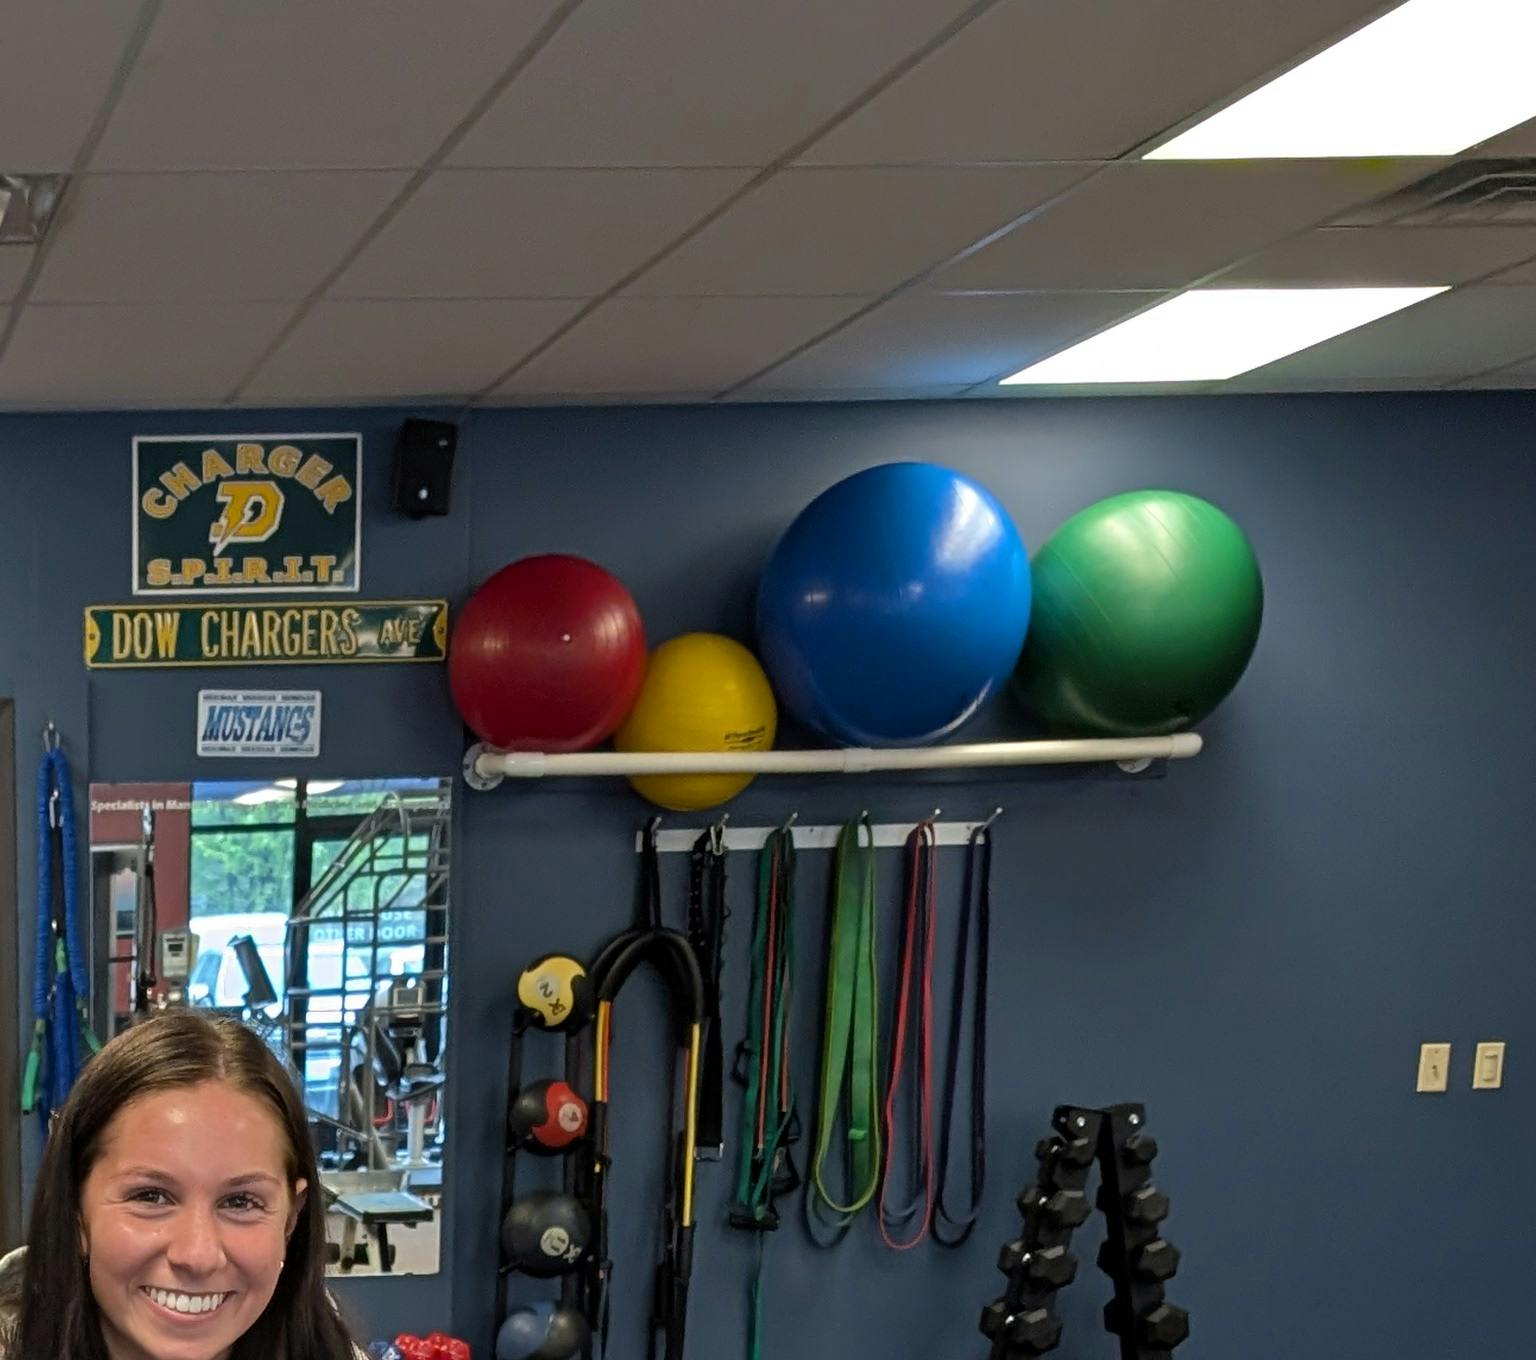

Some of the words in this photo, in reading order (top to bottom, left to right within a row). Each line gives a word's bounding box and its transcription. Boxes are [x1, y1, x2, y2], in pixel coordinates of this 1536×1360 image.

[141, 443, 352, 519] CHARGER
[208, 481, 285, 557] D
[113, 611, 181, 661] DOW
[201, 607, 362, 659] CHARGERS
[378, 617, 425, 645] AVE
[202, 705, 315, 746] MUSTANGS
